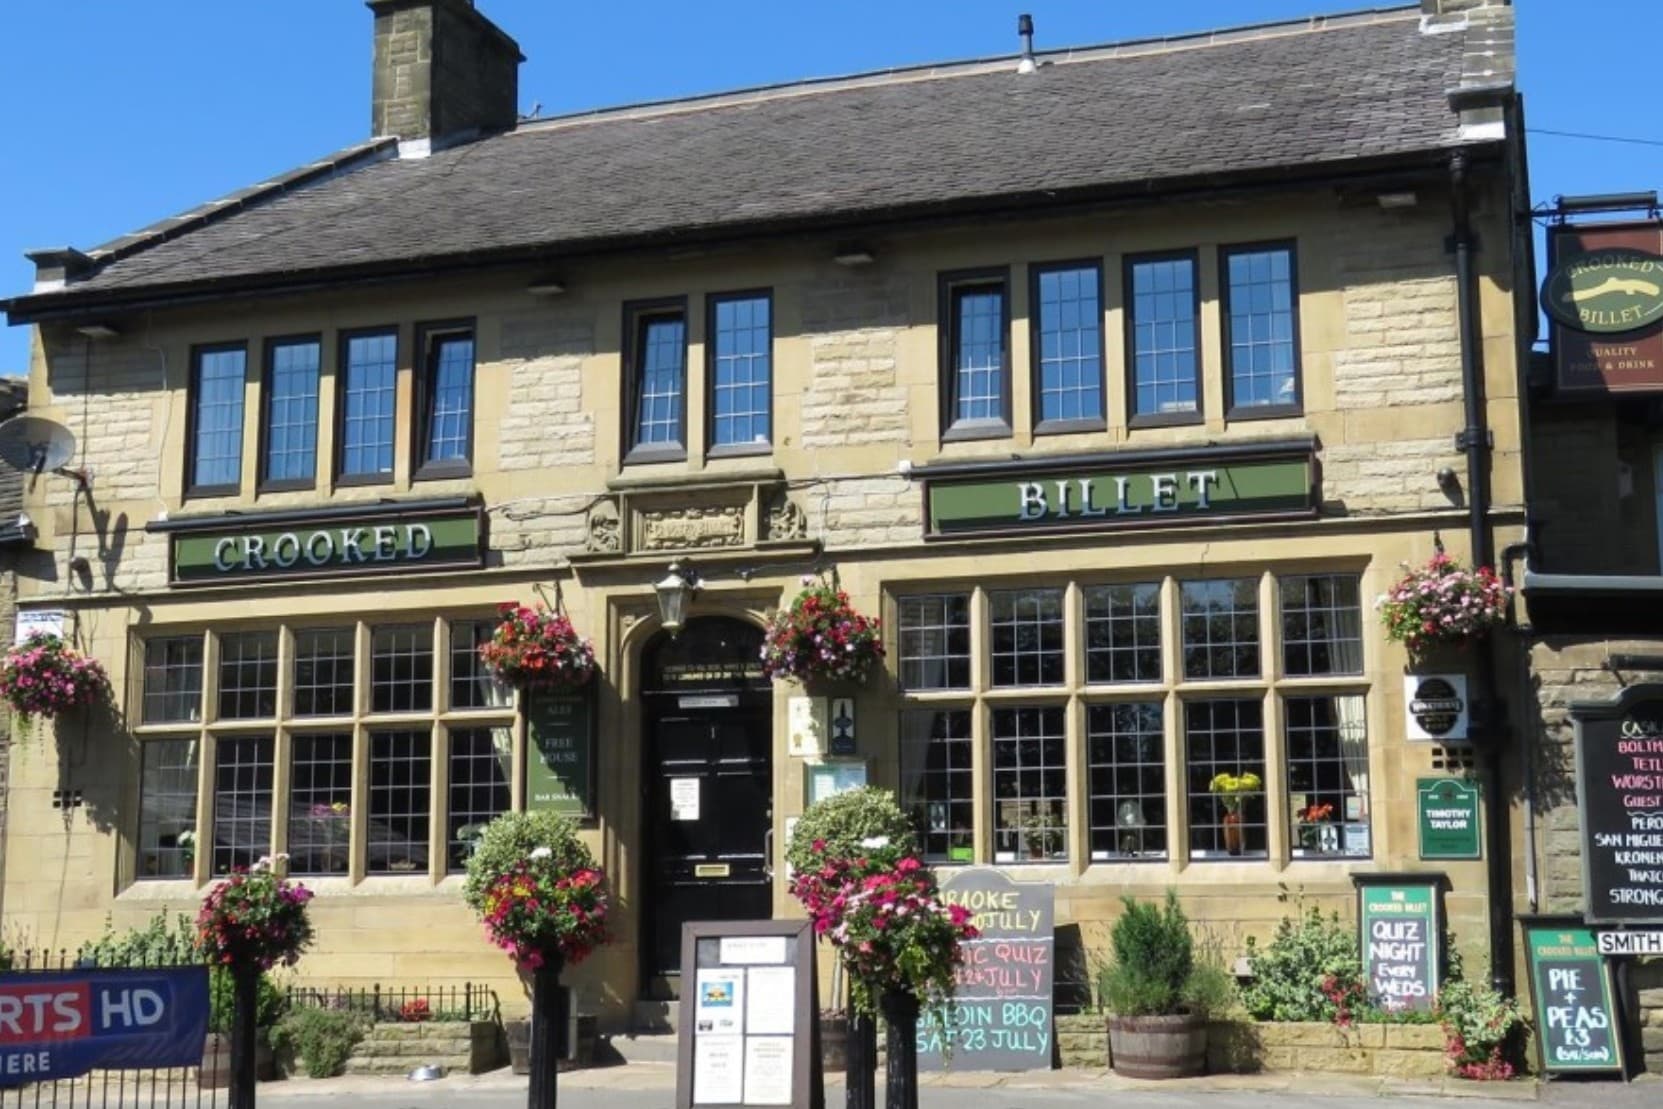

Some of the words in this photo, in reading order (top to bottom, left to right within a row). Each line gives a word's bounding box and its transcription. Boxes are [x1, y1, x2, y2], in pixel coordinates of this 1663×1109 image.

[1567, 255, 1654, 278] CROOKED
[1579, 305, 1643, 324] BILLET
[1618, 359, 1655, 369] DRINK
[1017, 470, 1217, 520] BILLET
[214, 523, 432, 571] CROOKED
[545, 737, 574, 748] FREE
[540, 751, 578, 764] HOUSE
[1623, 794, 1661, 808] GUEST
[1426, 809, 1471, 819] TIMOTHY
[1632, 817, 1663, 831] PERO
[1430, 820, 1467, 829] TAYLOR
[1594, 832, 1622, 847] SAN
[1609, 888, 1663, 905] STRONG
[985, 910, 1040, 931] JULY
[1372, 920, 1420, 940] QUIZ
[1369, 942, 1425, 962] NIGHT
[1602, 934, 1661, 951] SMITH
[995, 944, 1048, 965] QUIZ
[984, 967, 1042, 992] JULY
[1374, 977, 1425, 997] WEDS
[1549, 968, 1585, 990] PIE
[0, 992, 82, 1034] RTS
[101, 988, 165, 1029] HD
[1002, 1002, 1047, 1029] BBQ
[1547, 1006, 1608, 1028] PEAS
[916, 1029, 957, 1053] SAT
[963, 1029, 986, 1050] 23
[990, 1029, 1048, 1056] JULY
